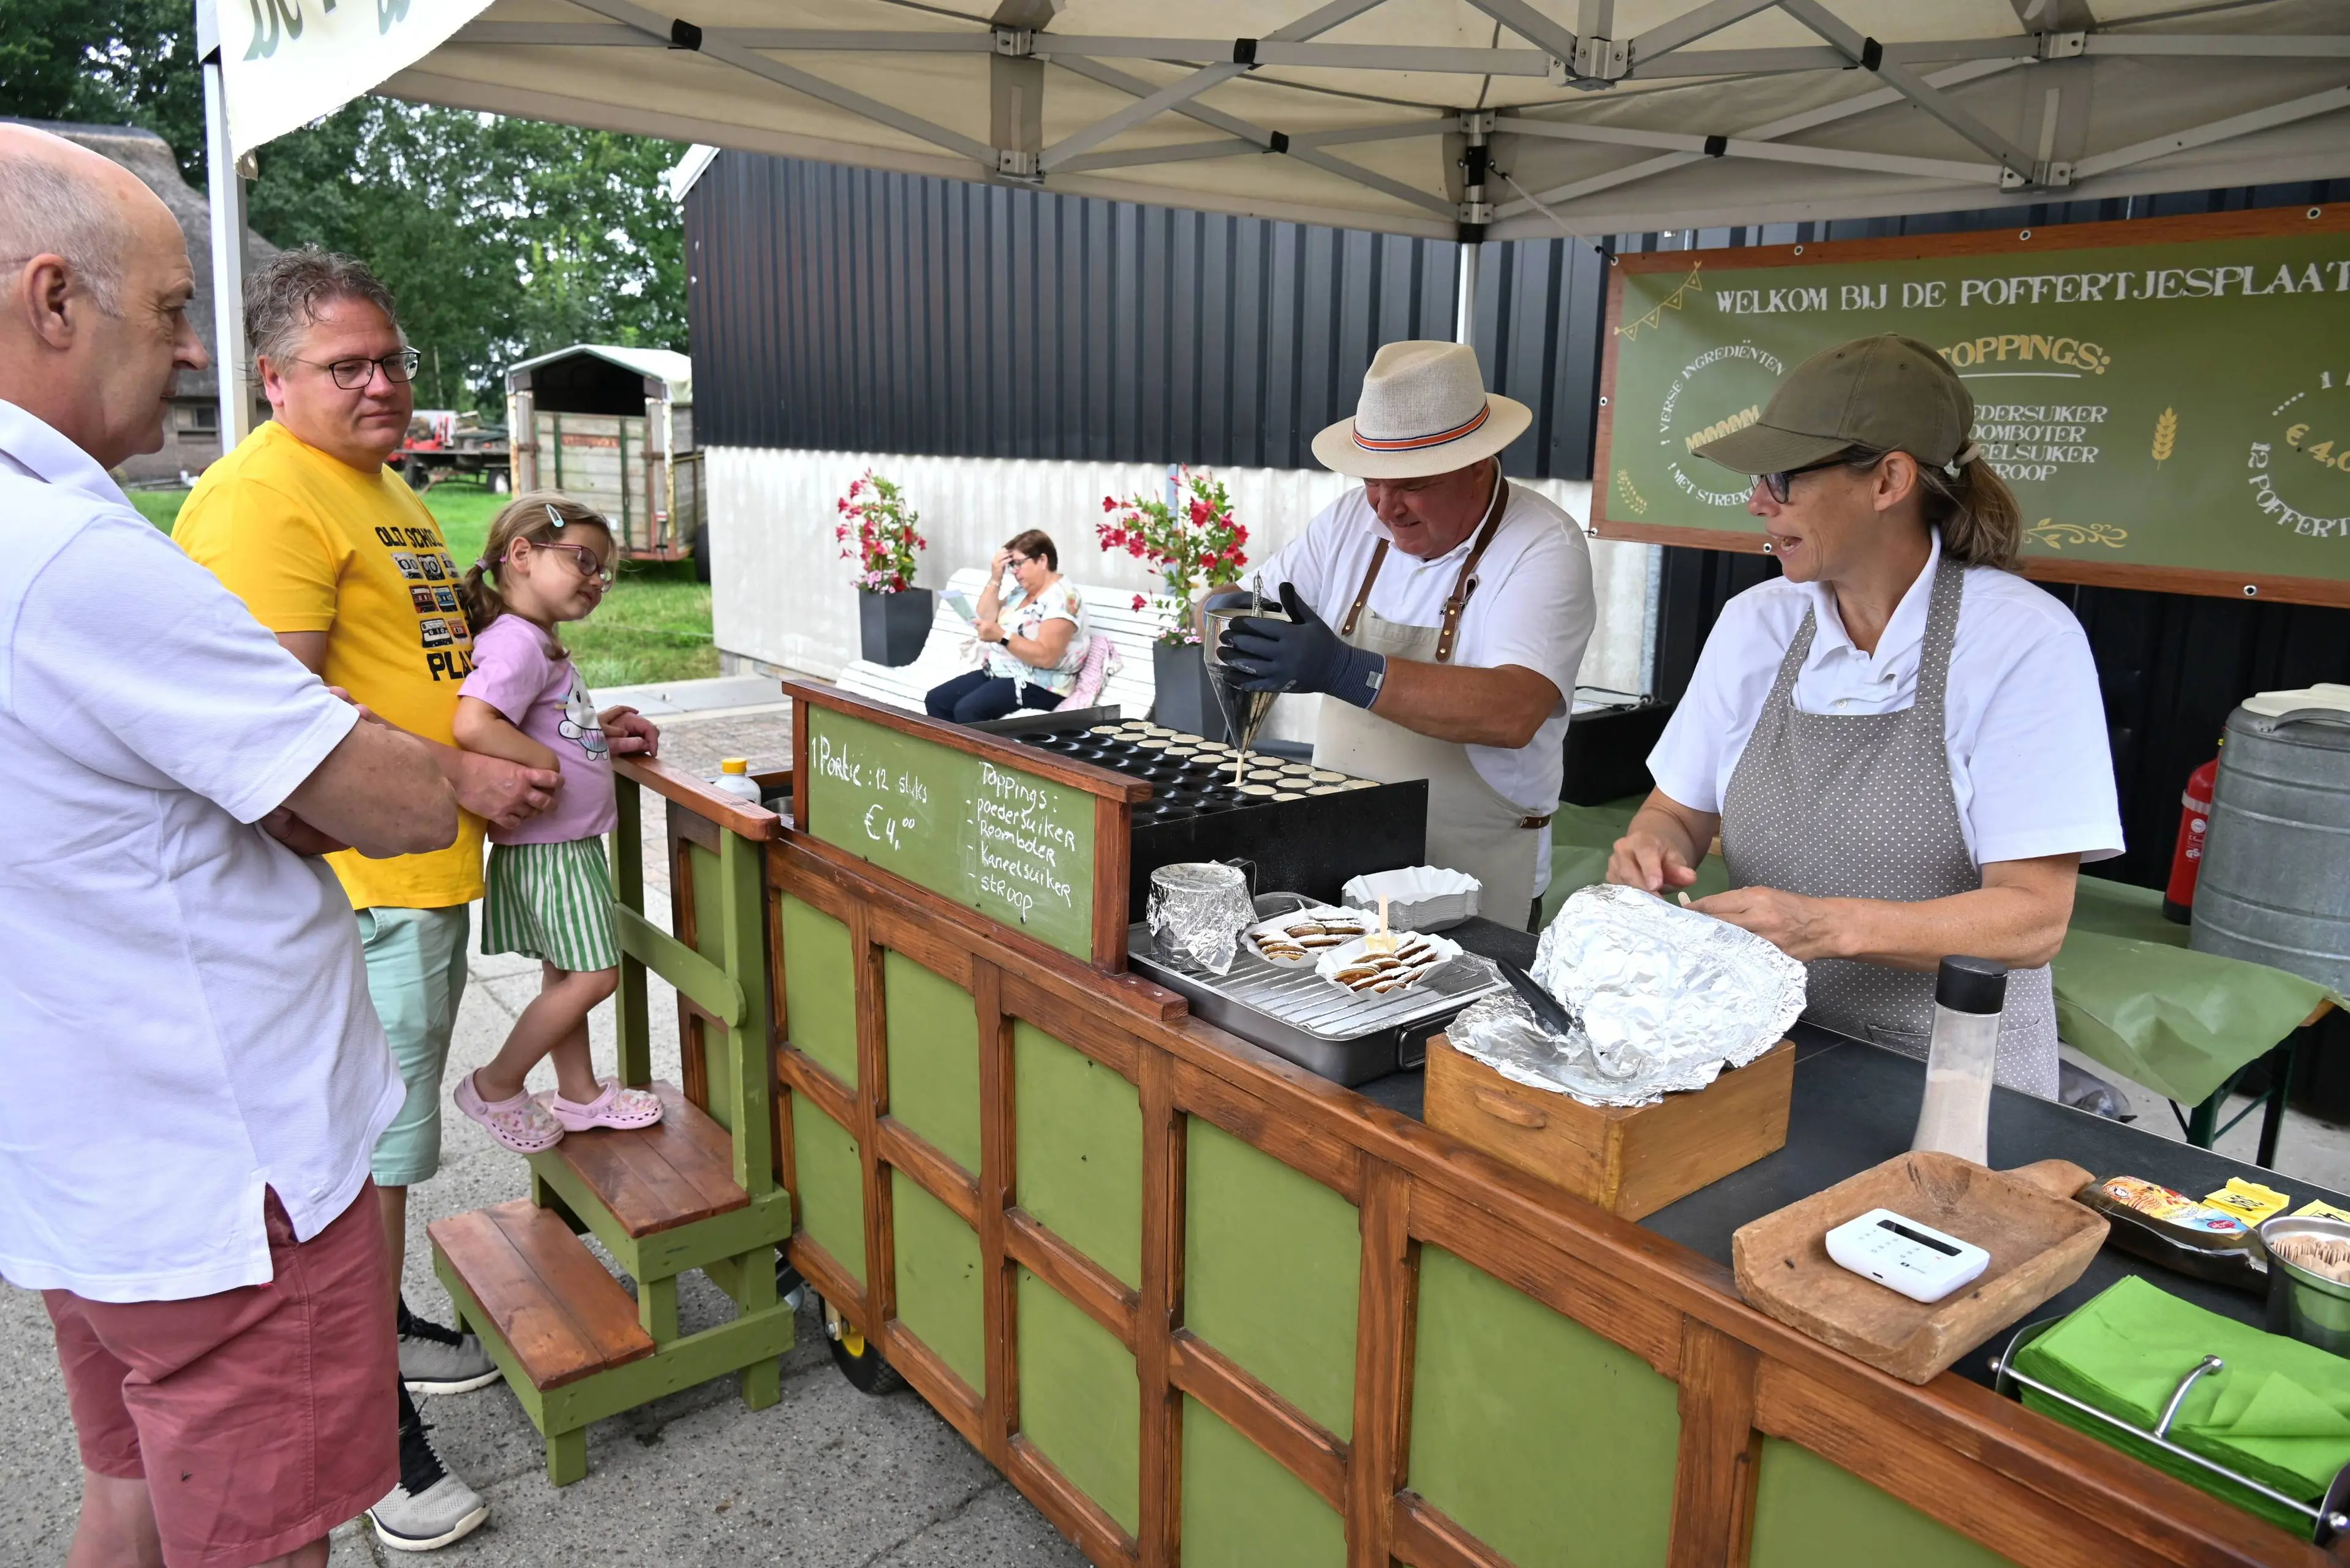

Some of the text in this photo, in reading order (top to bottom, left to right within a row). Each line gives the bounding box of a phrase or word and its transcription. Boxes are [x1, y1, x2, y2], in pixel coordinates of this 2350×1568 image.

[1716, 261, 2350, 314] WELKOM BIJ DE POFFERTJESPLAAT
[1660, 380, 1683, 433] VERSE
[1682, 339, 1786, 379] INGREDIËNTEN
[1674, 469, 1696, 494] MET
[375, 527, 407, 546] OLD
